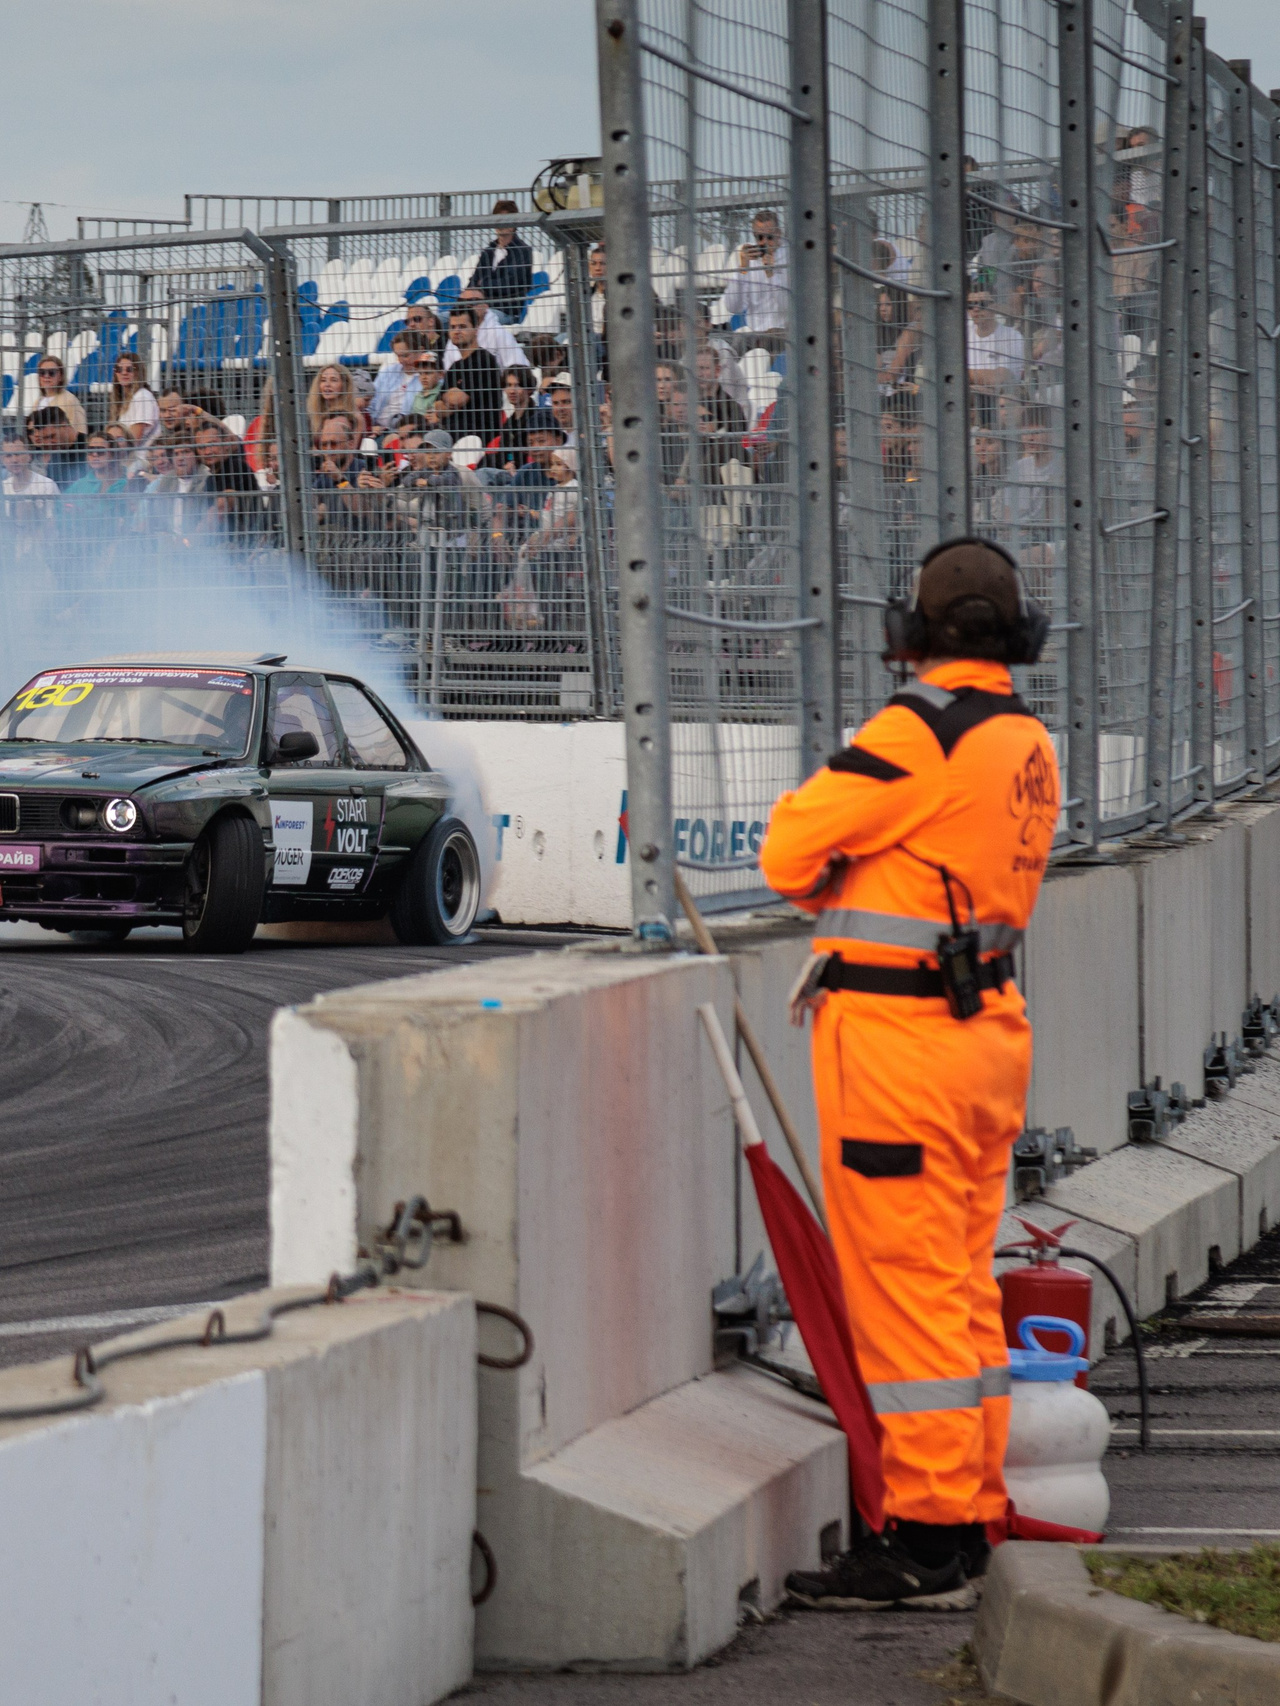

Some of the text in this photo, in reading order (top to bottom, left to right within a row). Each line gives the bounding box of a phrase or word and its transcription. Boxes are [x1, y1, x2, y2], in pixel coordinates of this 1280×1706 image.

[61, 671, 199, 680] КУБОК САНКТ-ПЕТЕРБУРГА
[16, 682, 94, 711] 130
[337, 799, 367, 822] START
[275, 815, 305, 830] KINFOREST
[337, 828, 369, 853] VOLT
